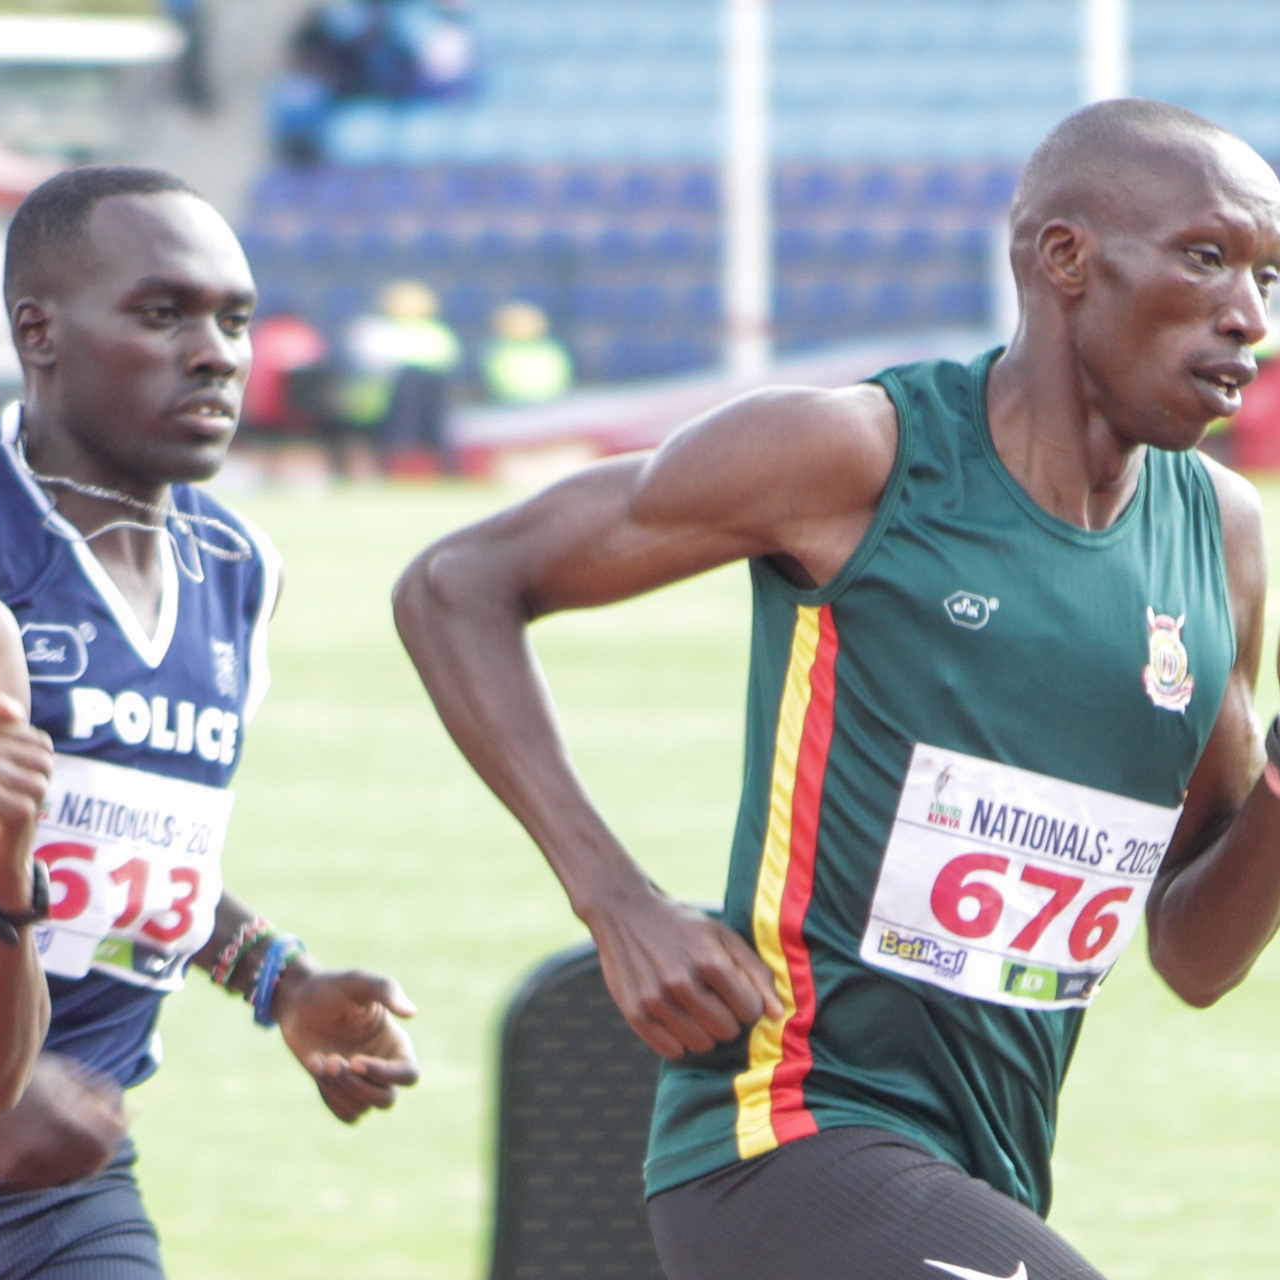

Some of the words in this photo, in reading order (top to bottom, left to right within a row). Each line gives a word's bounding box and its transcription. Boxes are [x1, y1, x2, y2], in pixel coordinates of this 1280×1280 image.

[69, 687, 239, 766] POLICE
[33, 842, 202, 945] 613
[1116, 838, 1166, 875] 2025
[930, 852, 1134, 963] 676
